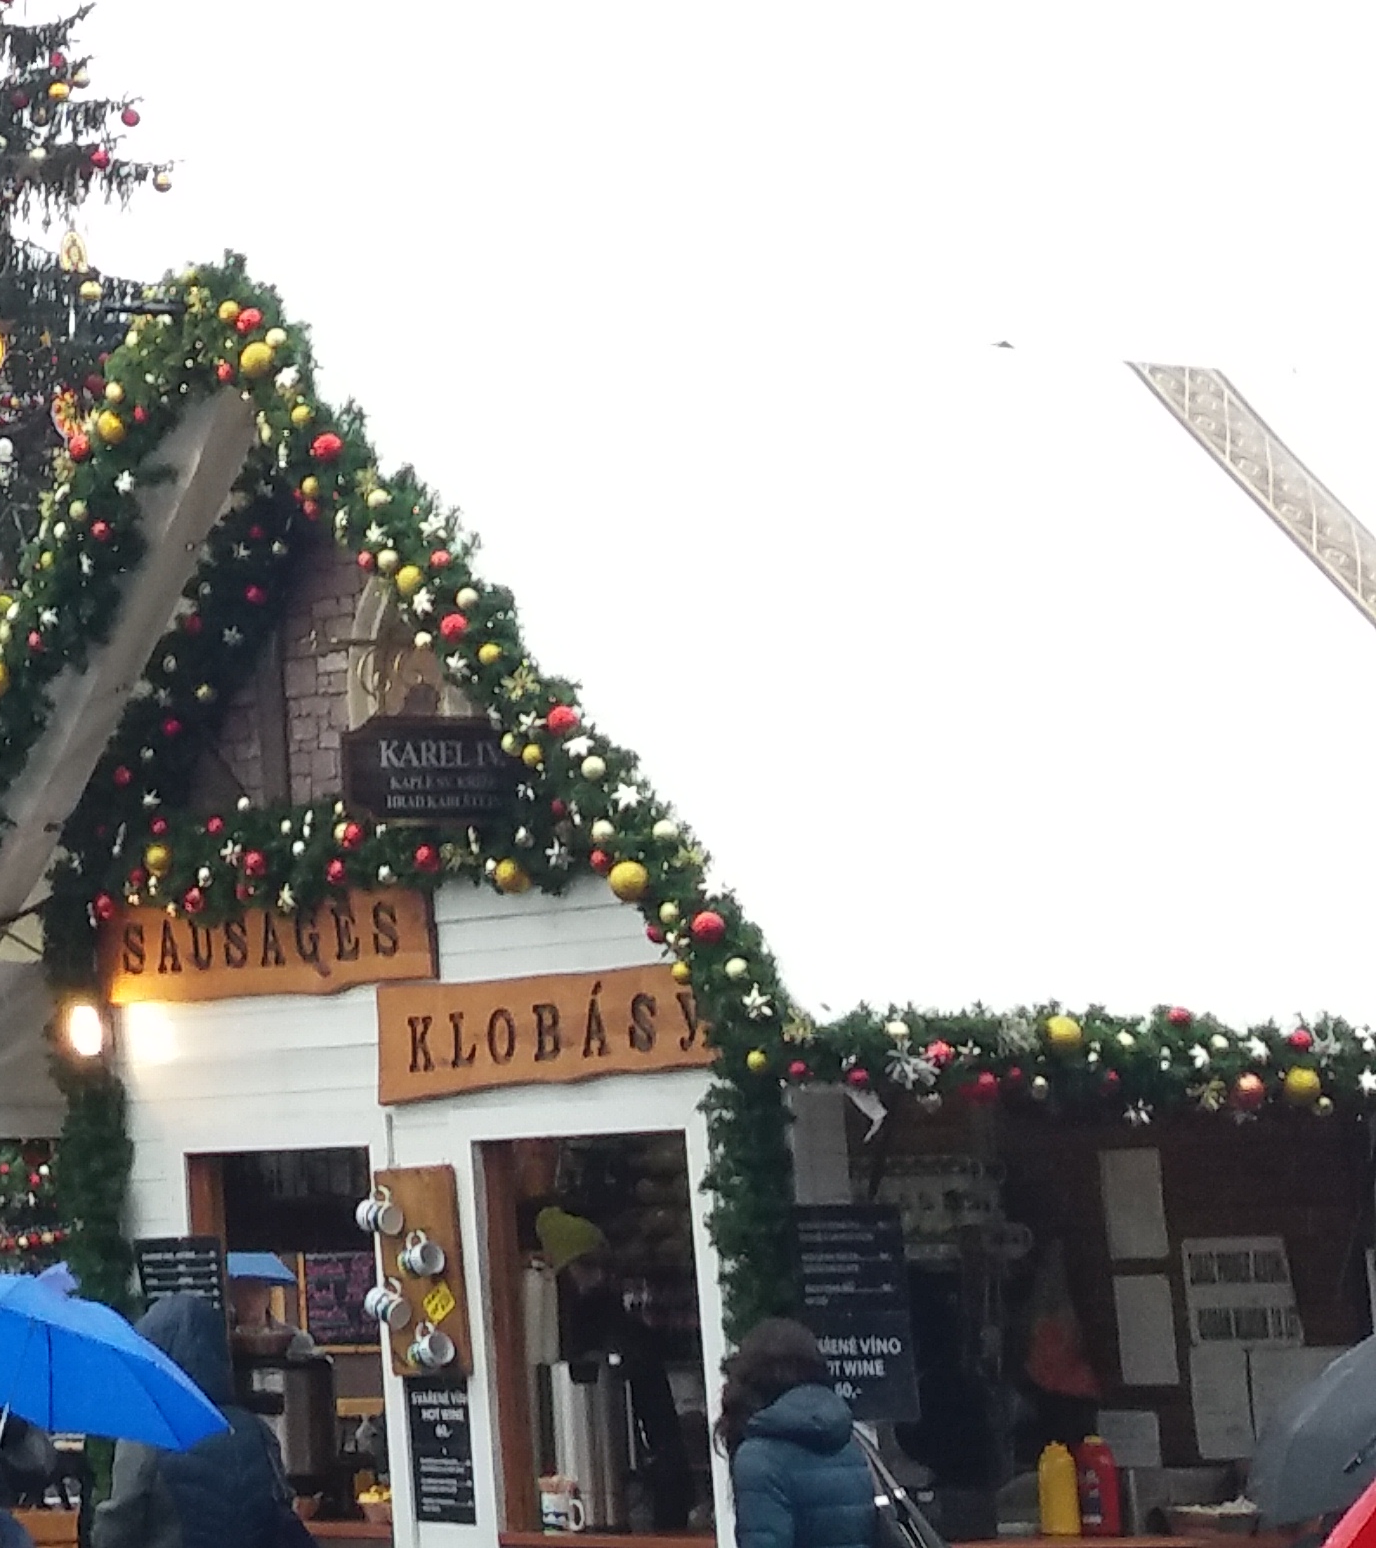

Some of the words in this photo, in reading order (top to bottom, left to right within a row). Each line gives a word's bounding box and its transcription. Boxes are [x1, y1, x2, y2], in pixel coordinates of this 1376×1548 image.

[379, 738, 470, 768] KAREL
[122, 901, 400, 977] SAUSAGES
[860, 1334, 902, 1355] VÍNO
[843, 1359, 886, 1377] WINE
